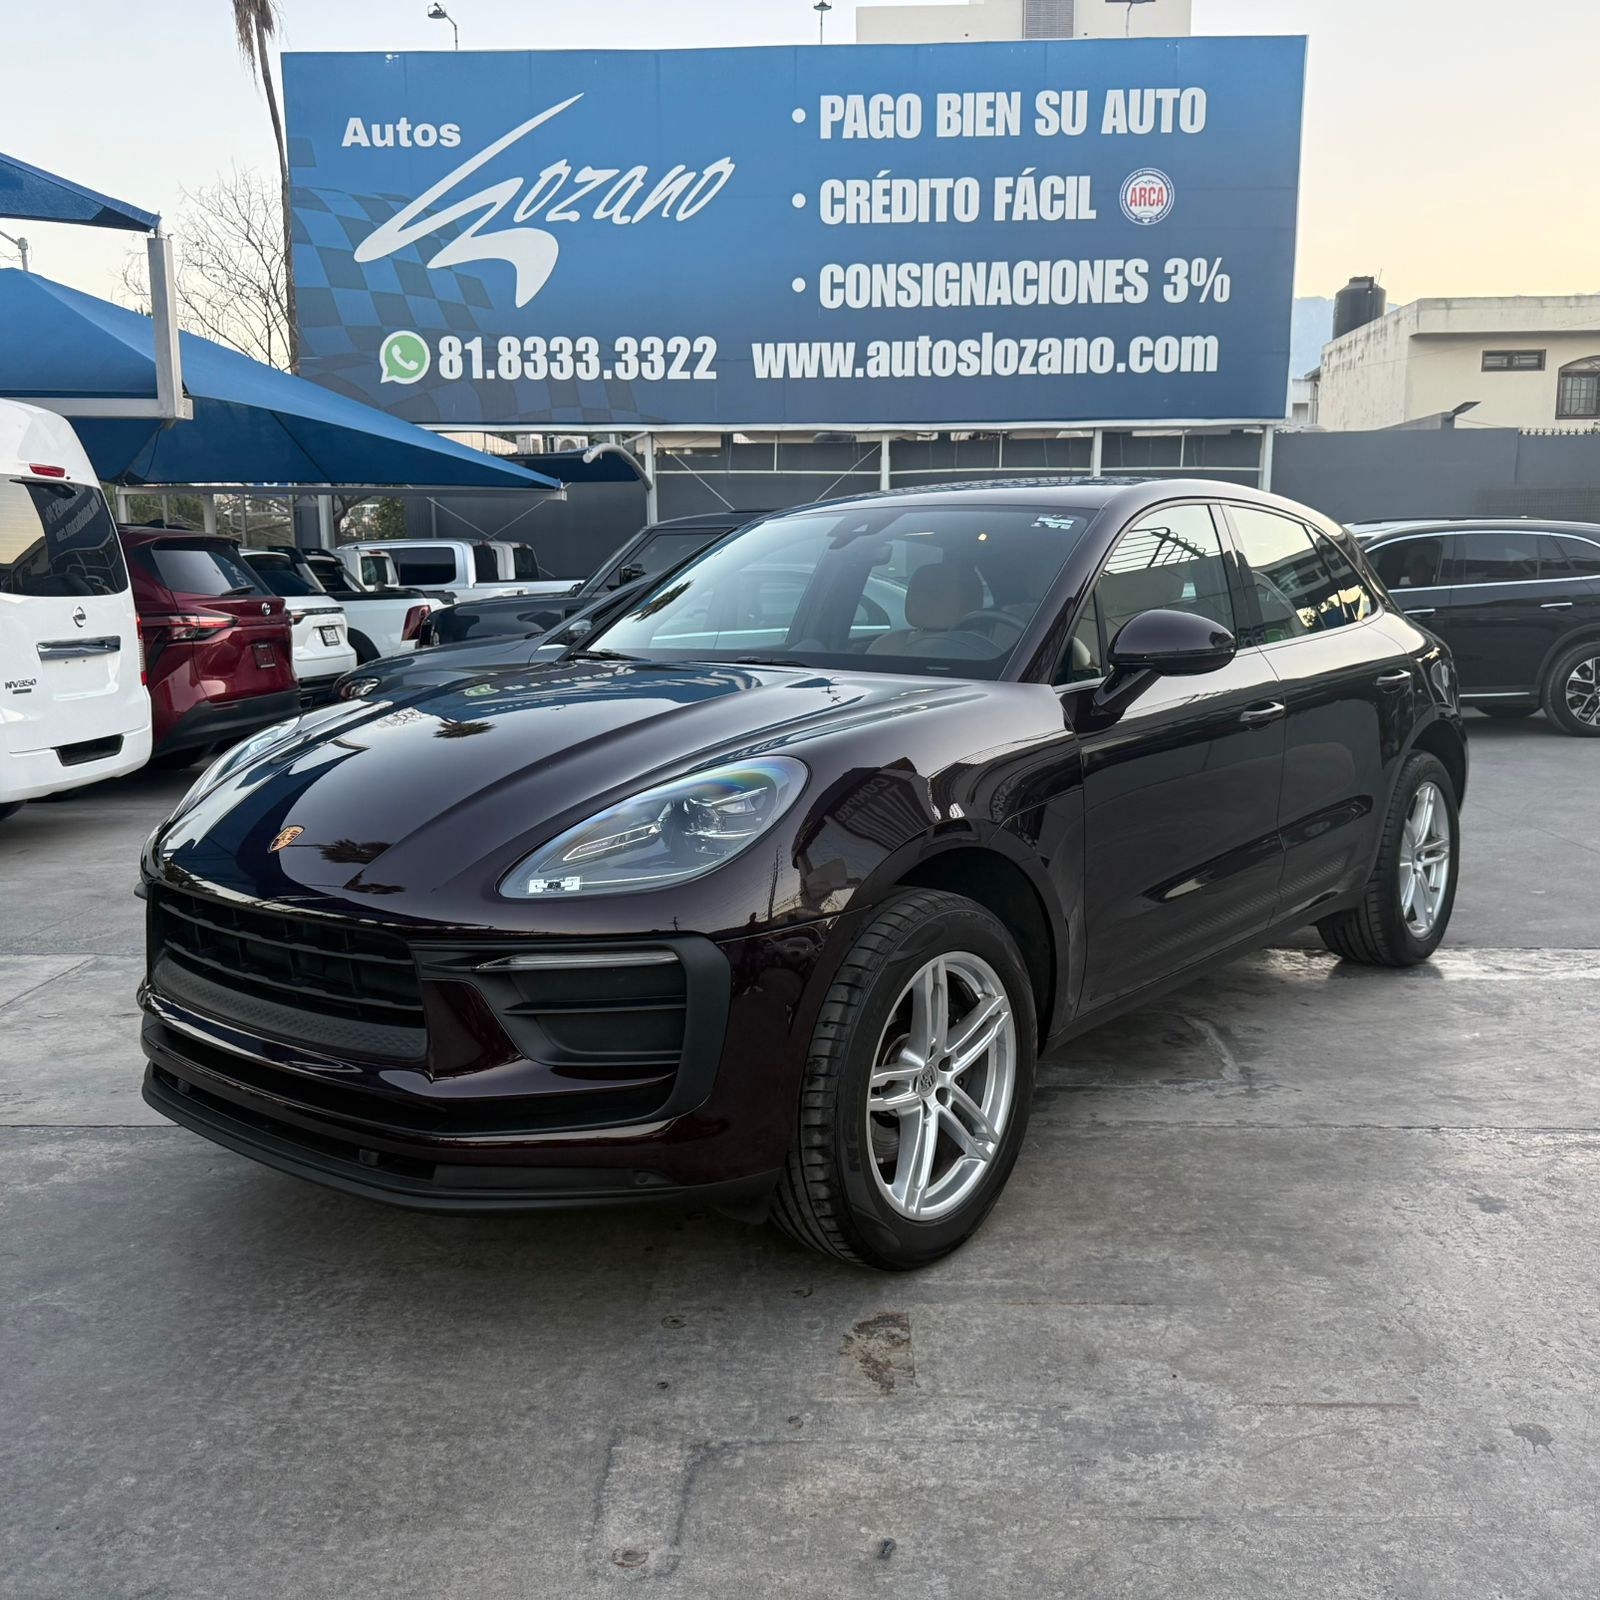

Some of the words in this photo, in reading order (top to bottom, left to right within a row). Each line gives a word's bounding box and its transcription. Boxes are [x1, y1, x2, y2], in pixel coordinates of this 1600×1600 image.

[341, 117, 461, 148] Autos
[820, 93, 922, 140] PAGO
[936, 91, 1021, 138] BIEN
[1034, 90, 1088, 136] SU
[1100, 87, 1207, 135] AUTO
[354, 93, 735, 308] Lozano
[820, 170, 980, 225] CRÉDITO
[993, 167, 1097, 221] FÁCIL
[1129, 186, 1165, 207] ARCA
[820, 258, 1149, 309] CONSIGNACIONES
[1163, 257, 1231, 304] 3%
[438, 335, 717, 381] 81.8333.3322
[751, 332, 1219, 379] www.autoslozano.com
